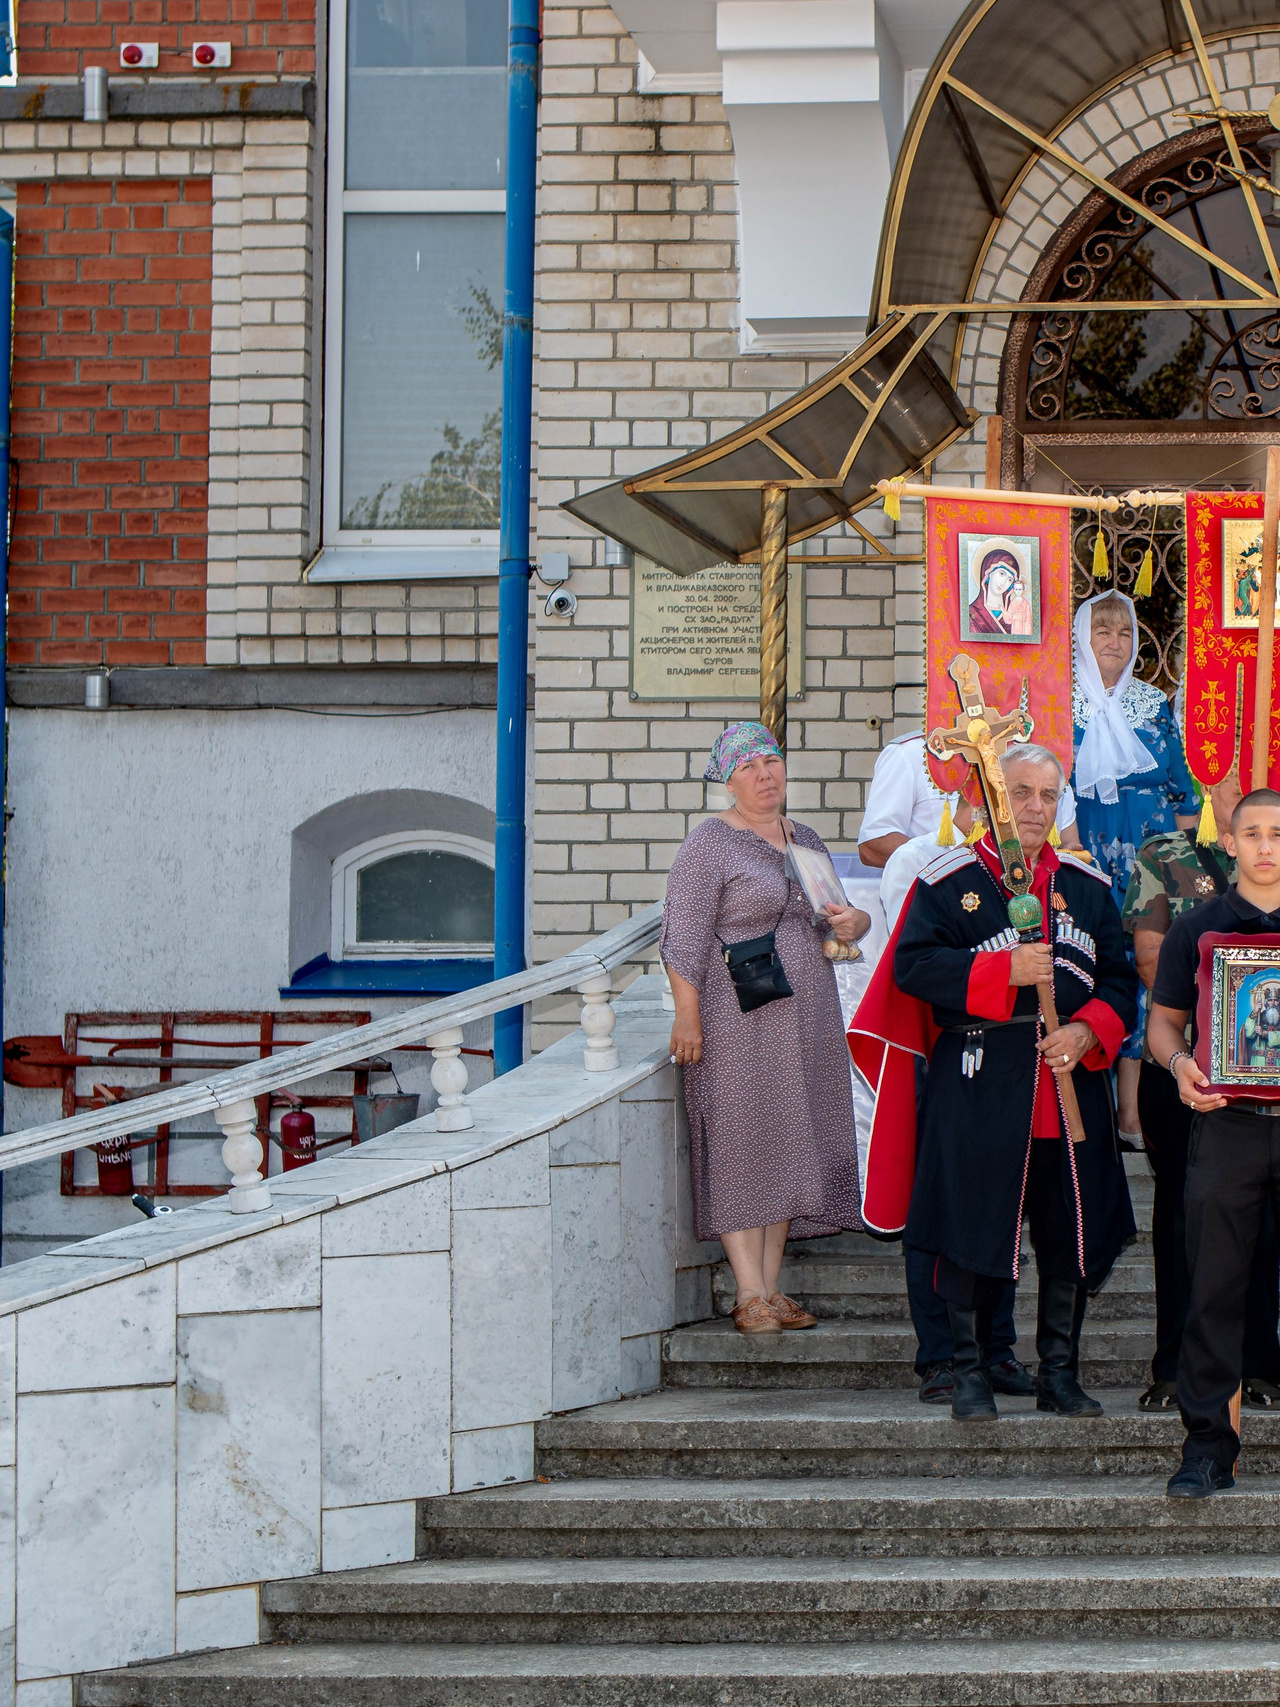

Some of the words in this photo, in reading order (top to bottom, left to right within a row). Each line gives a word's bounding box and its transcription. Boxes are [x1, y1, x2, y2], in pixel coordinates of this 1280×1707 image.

[646, 584, 653, 592] И
[656, 584, 745, 592] ВЛАДИКАВКАЗСКОГО
[713, 595, 740, 603] 2000г.
[658, 605, 664, 613] И
[667, 605, 714, 613] ПОСТРОЕН
[716, 605, 729, 613] НА
[684, 615, 697, 623] СХ
[661, 626, 679, 634] ПРИ
[682, 626, 728, 634] АКТИВНОМ
[732, 626, 762, 634] УЧАСТ
[639, 636, 695, 645] АКЦИОНЕРОВ
[697, 636, 704, 644] И
[705, 635, 746, 644] ЖИТЕЛЕЙ
[640, 646, 687, 655] КТИТОРОМ
[689, 646, 712, 655] СЕГО
[714, 646, 744, 654] ХРАМА
[703, 657, 733, 665] СУРОВ
[666, 667, 715, 676] ВЛАДИМИР
[718, 667, 762, 676] СЕРГЕЕВИ
